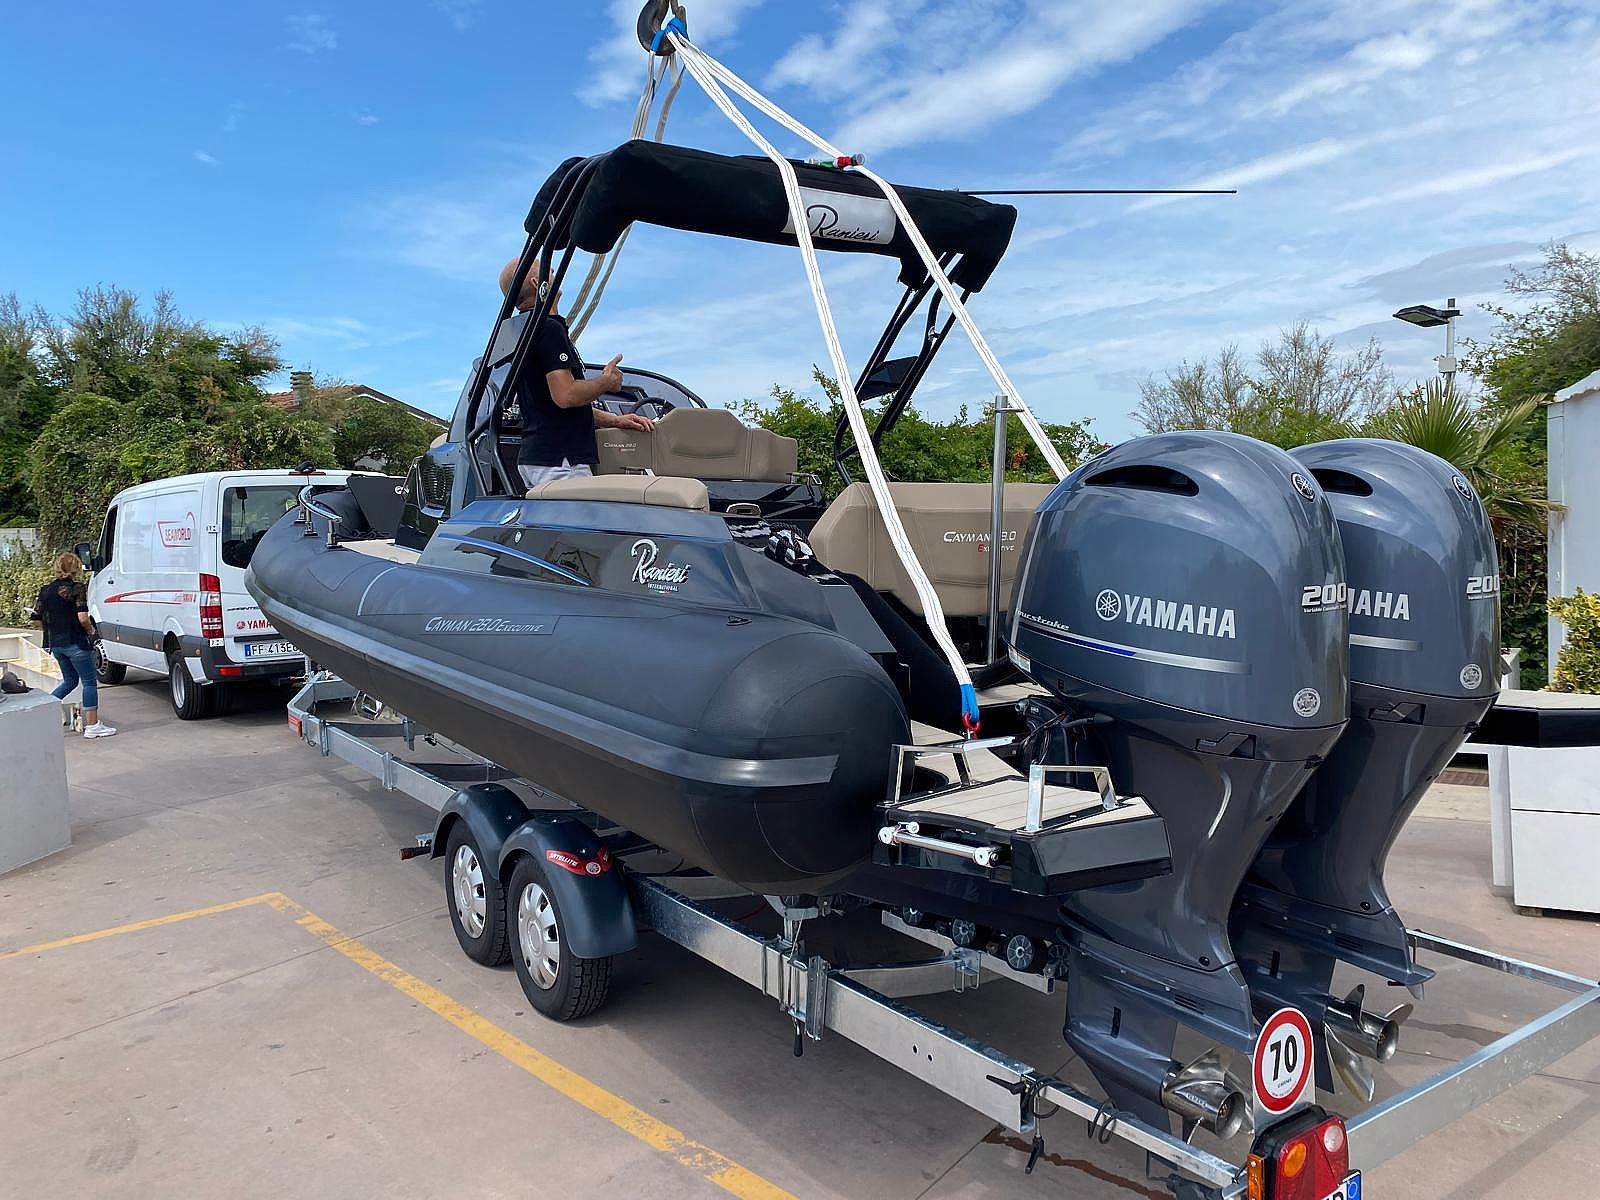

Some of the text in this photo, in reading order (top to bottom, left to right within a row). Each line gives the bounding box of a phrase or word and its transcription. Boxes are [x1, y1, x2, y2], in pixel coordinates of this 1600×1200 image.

[806, 204, 880, 241] Ranieri
[943, 531, 991, 542] CAYMAN
[631, 539, 692, 584] Ranieri
[1301, 582, 1347, 606] 200
[1466, 575, 1500, 594] 200
[1347, 587, 1410, 621] AHA
[247, 620, 272, 630] YAMA
[424, 616, 473, 632] CAYMAN
[1123, 594, 1236, 639] YAMAHA
[251, 645, 264, 655] FF
[549, 852, 578, 867] SATELLITE
[1270, 1034, 1298, 1082] 70
